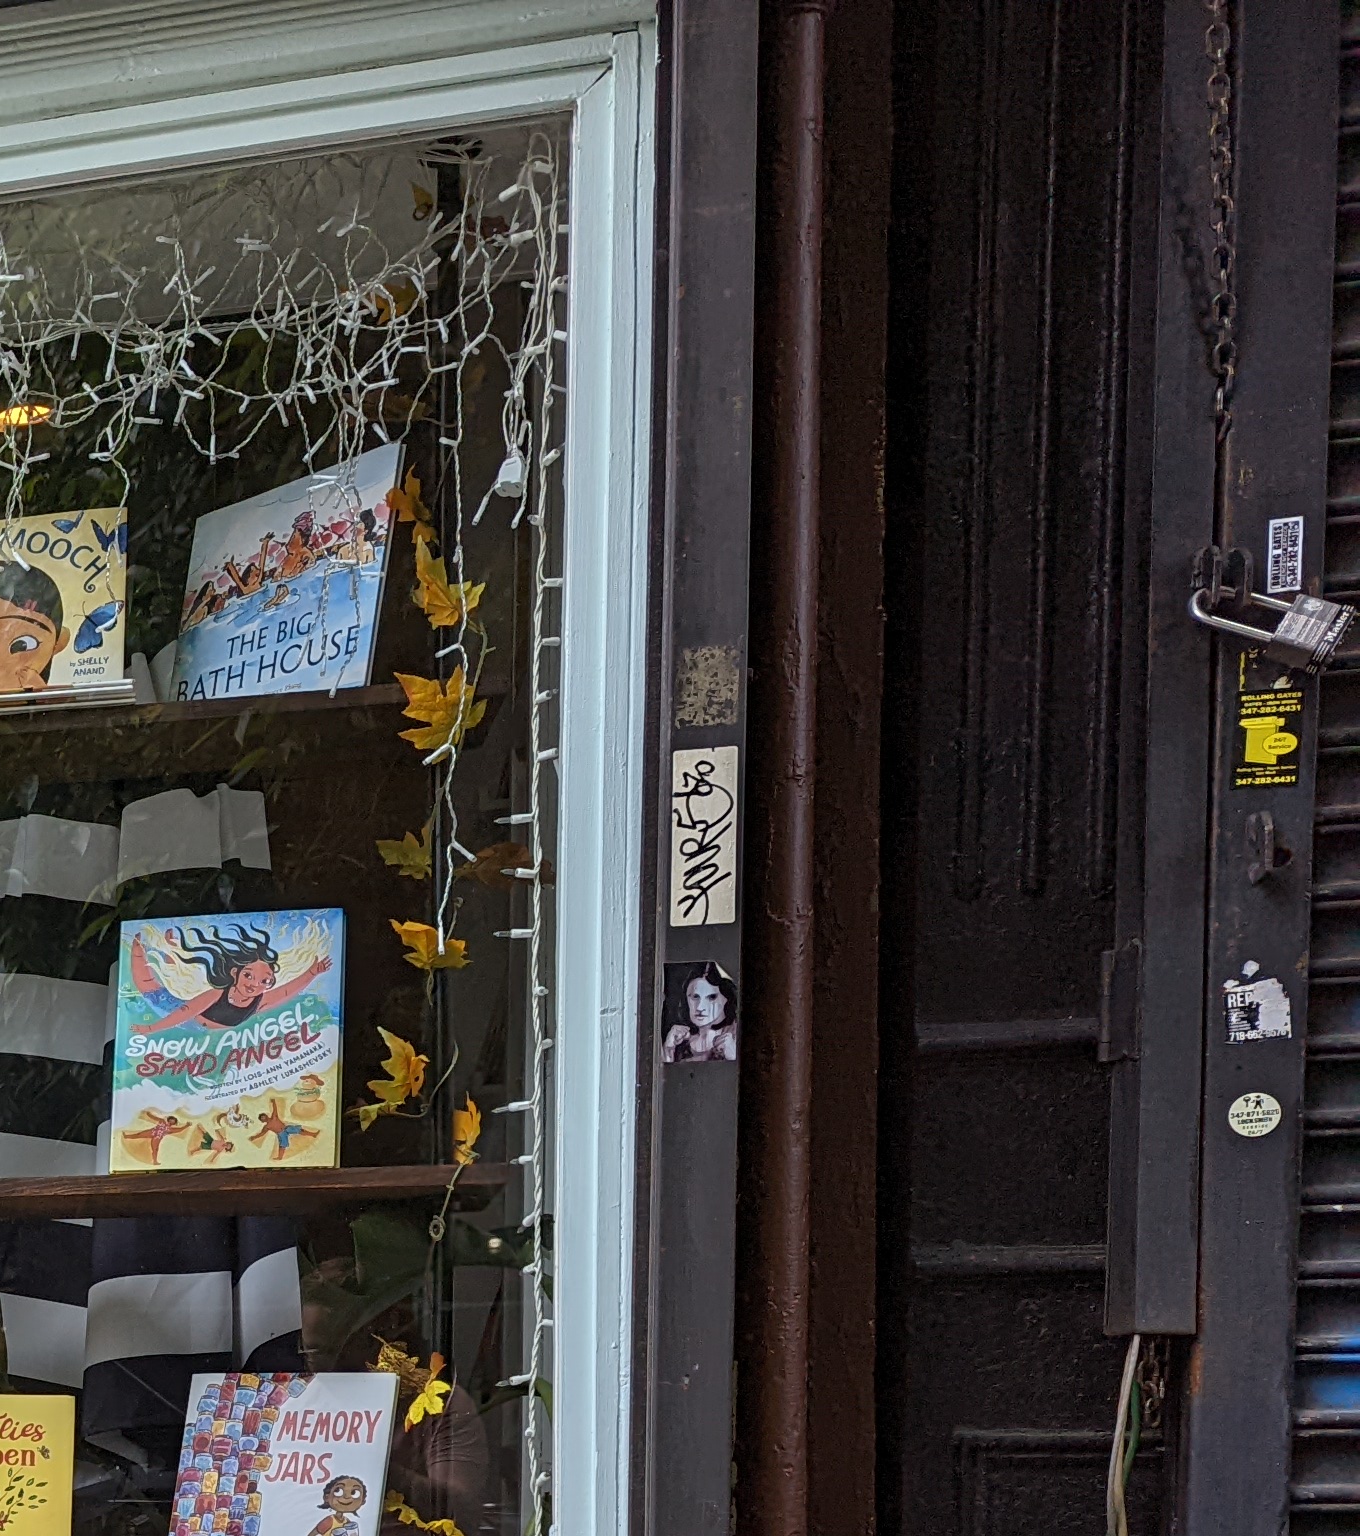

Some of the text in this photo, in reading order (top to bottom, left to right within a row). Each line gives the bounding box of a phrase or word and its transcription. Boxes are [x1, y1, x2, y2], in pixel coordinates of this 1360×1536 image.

[4, 527, 110, 594] MOOCH
[226, 611, 314, 659] THE BIG
[1324, 611, 1351, 643] Master
[72, 666, 106, 678] ANAND
[77, 656, 110, 667] SHELLY
[177, 624, 361, 701] BATH HOUSE
[1227, 991, 1257, 1009] REP
[125, 1034, 211, 1058] SNOW
[135, 1021, 322, 1078] SAND ANGEL
[276, 1409, 383, 1445] MEMORY
[263, 1451, 334, 1485] JARS
